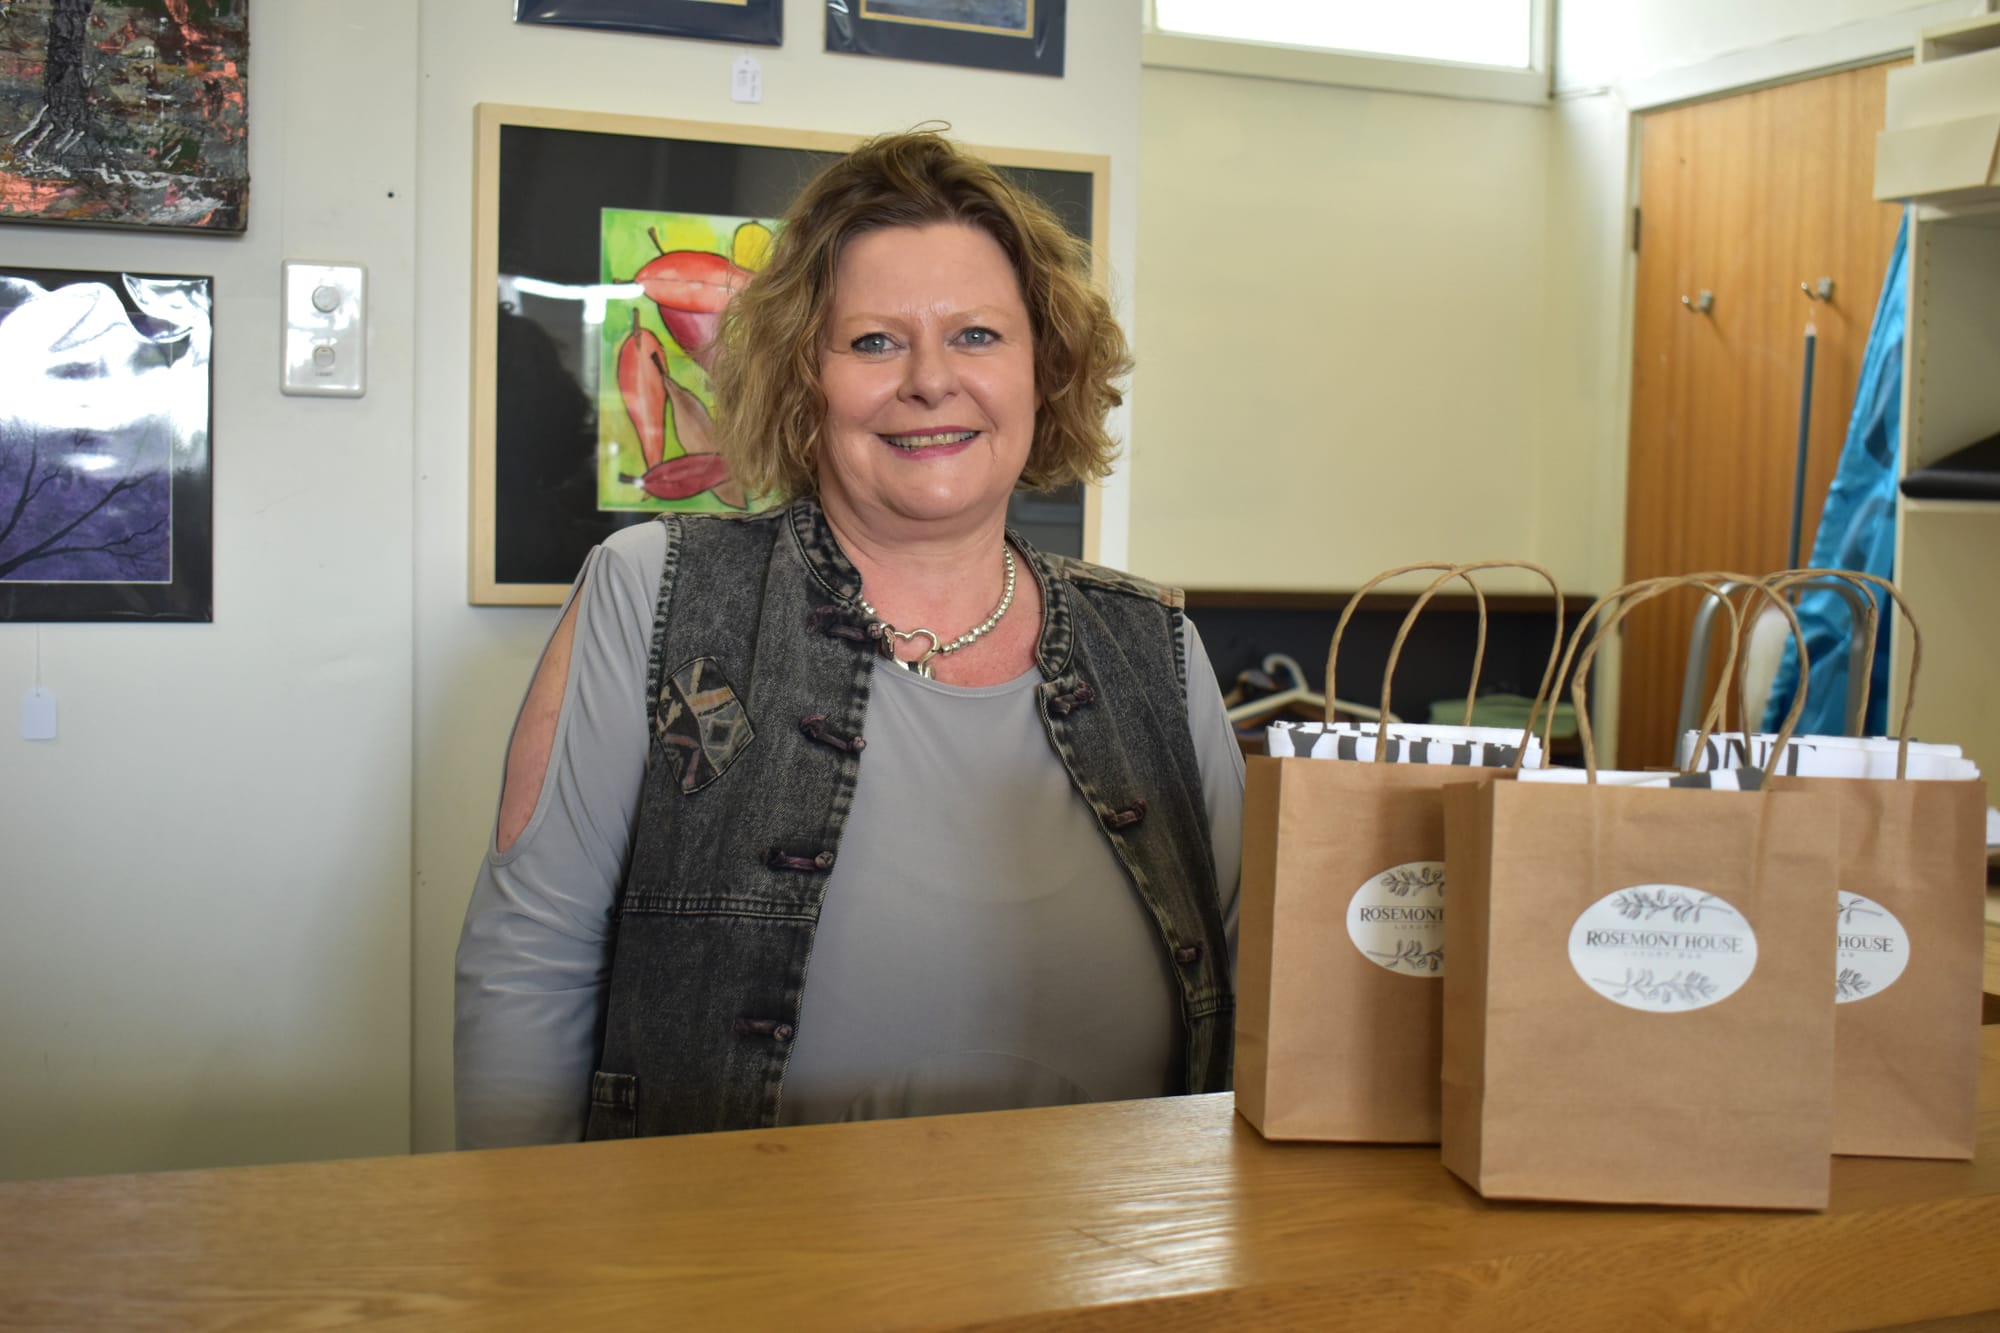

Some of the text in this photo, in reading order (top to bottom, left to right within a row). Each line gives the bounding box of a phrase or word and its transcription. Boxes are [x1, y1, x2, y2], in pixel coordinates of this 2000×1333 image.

[1360, 907, 1444, 921] ROSEMONT
[1586, 931, 1742, 952] ROSEMONT HOUSE
[1838, 936, 1893, 952] HOUSE
